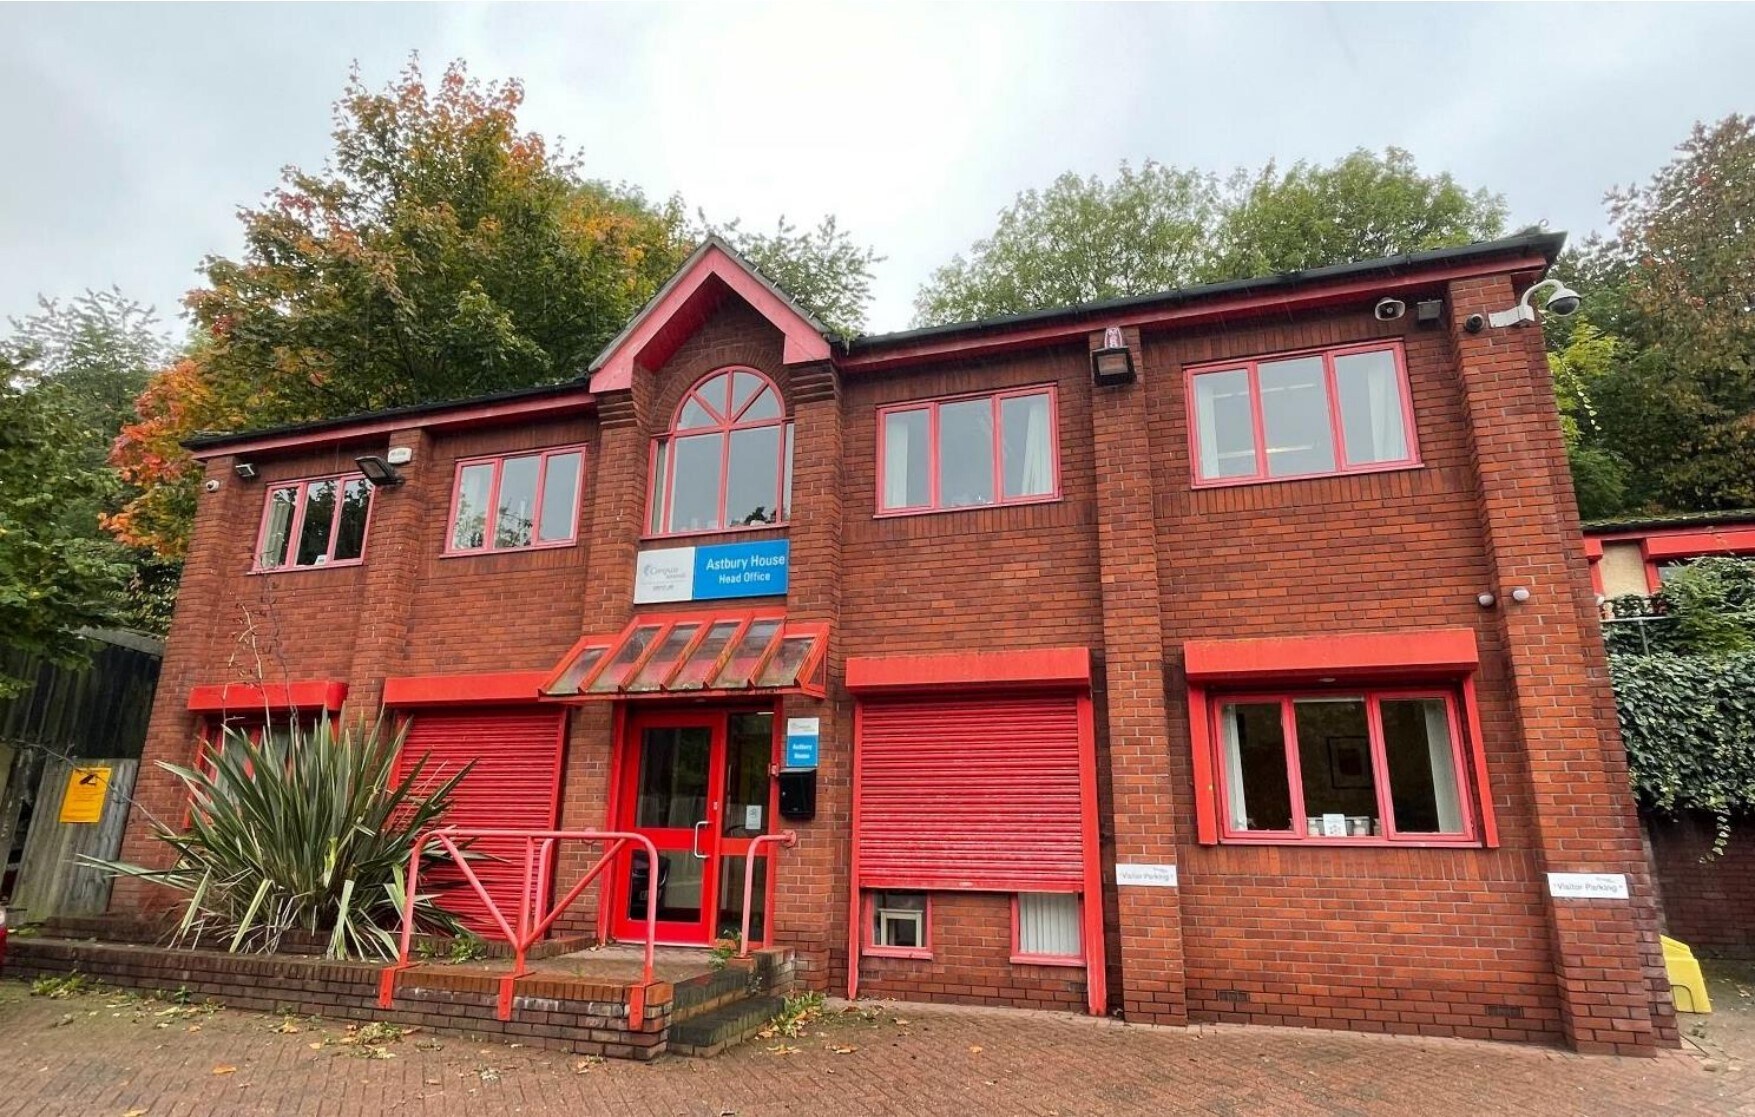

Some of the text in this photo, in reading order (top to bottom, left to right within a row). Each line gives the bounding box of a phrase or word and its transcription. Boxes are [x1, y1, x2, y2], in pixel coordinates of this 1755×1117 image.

[706, 554, 785, 571] Astbury House
[718, 571, 771, 584] Head Office
[1557, 882, 1618, 893] Visitor Parking
